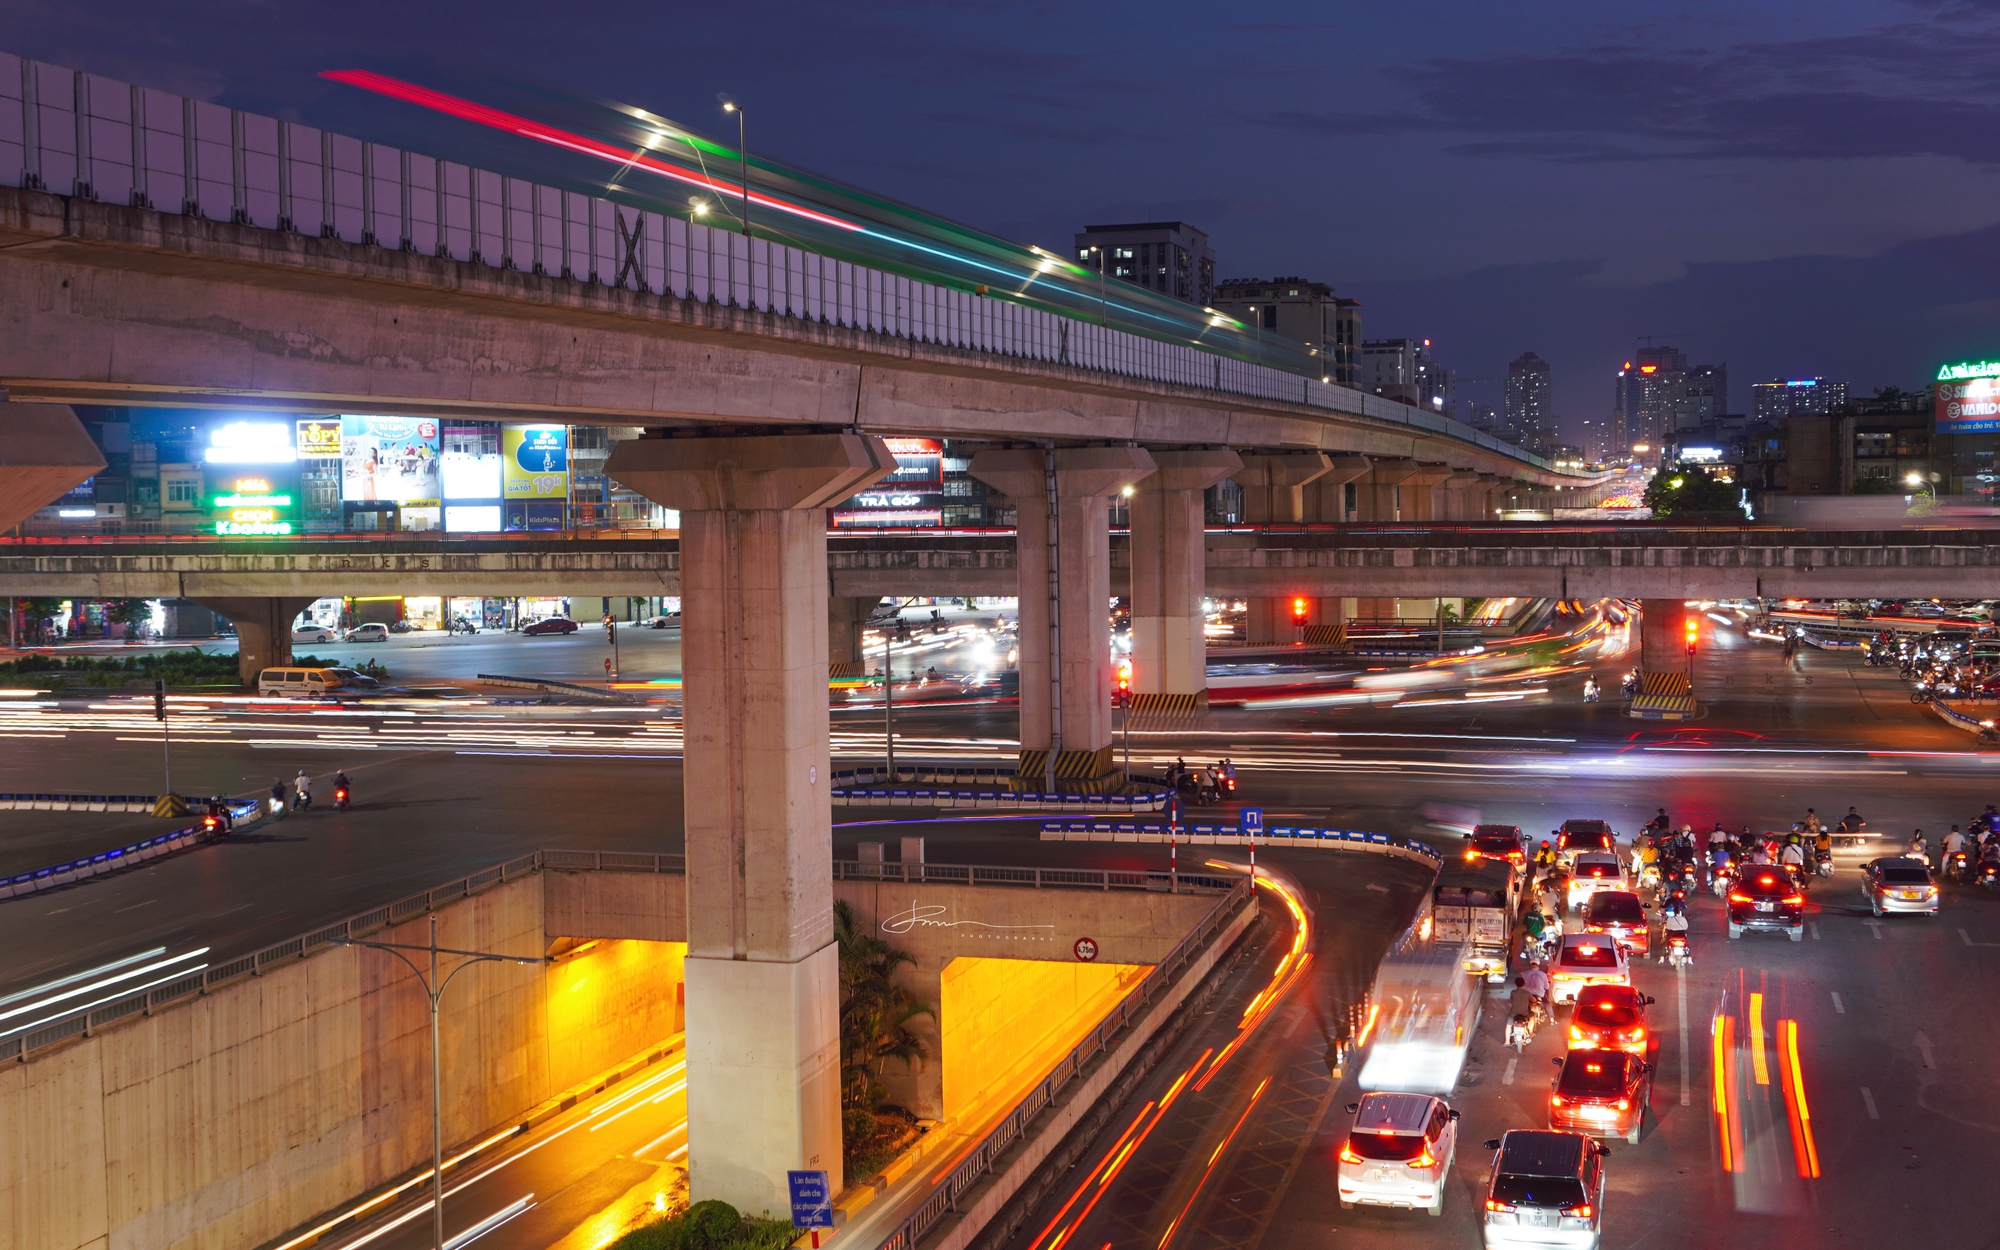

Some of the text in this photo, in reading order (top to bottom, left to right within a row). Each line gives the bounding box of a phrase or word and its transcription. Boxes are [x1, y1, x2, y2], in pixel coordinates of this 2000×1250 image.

[859, 495, 920, 507] TRẢ GÓP
[812, 1189, 821, 1197] cho
